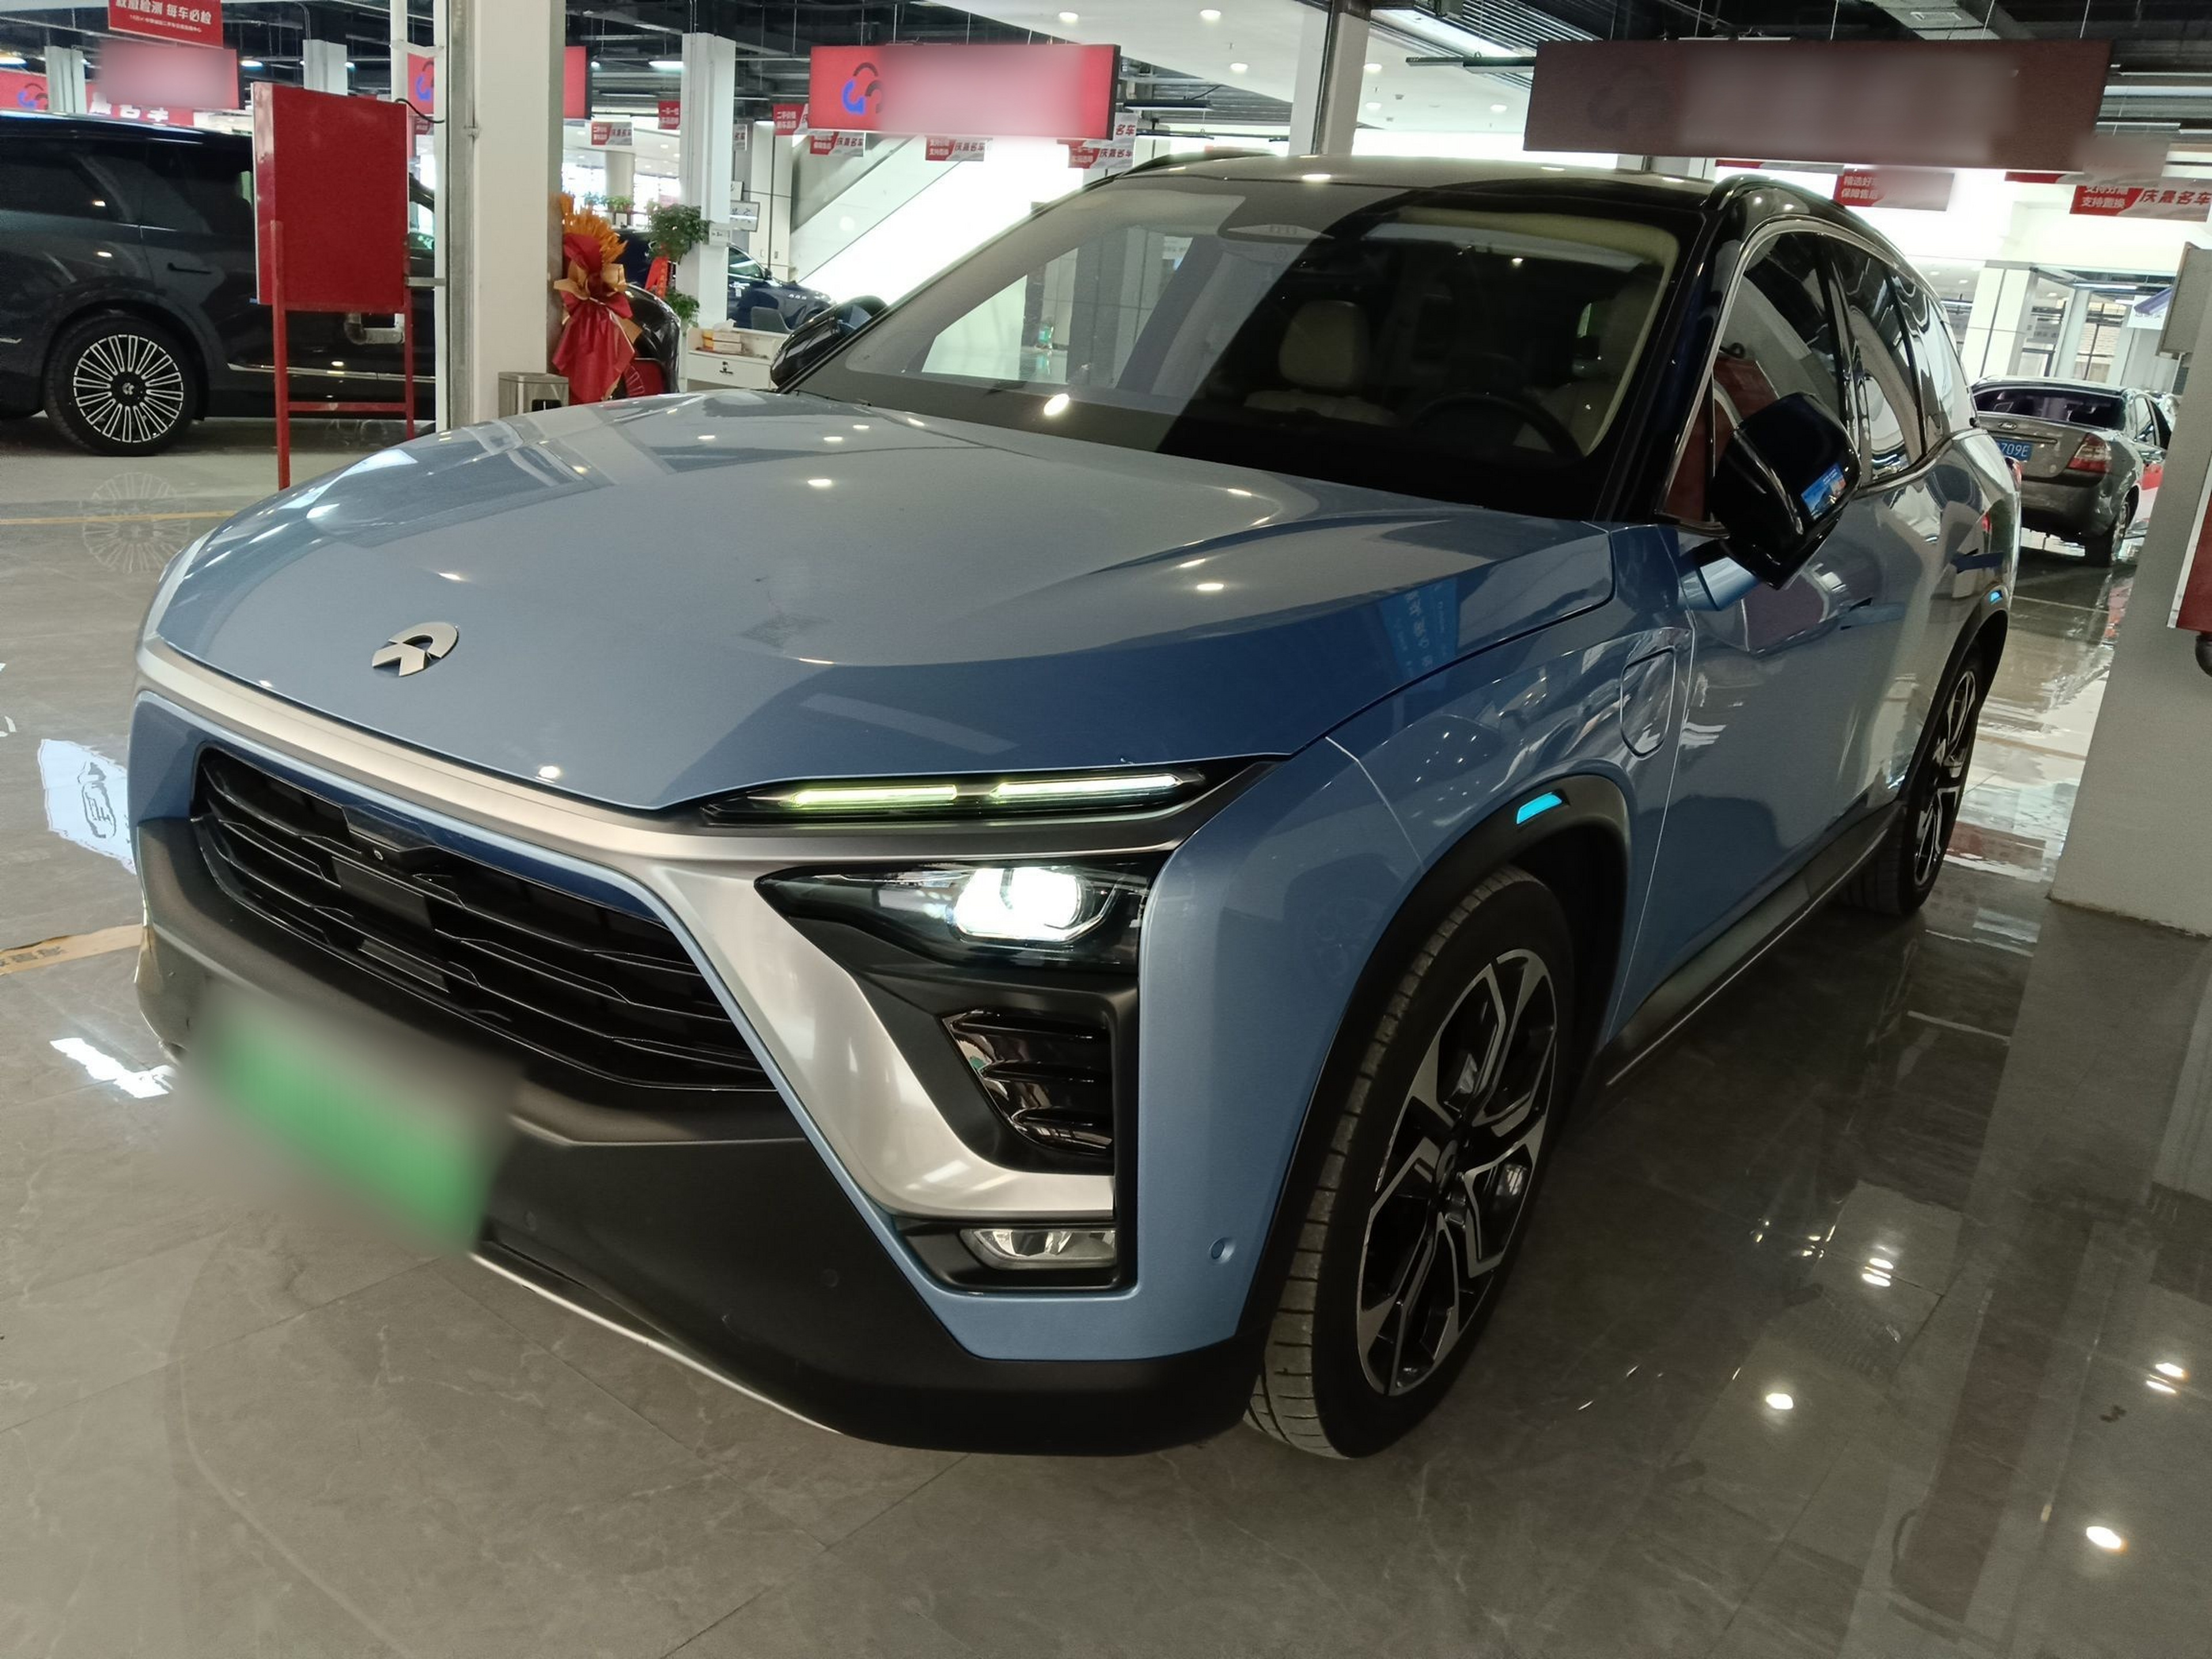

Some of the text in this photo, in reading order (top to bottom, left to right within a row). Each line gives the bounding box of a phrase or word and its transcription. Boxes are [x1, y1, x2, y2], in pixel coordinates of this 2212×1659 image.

[167, 4, 211, 25] 每车必检
[1997, 441, 2031, 457] 709E
